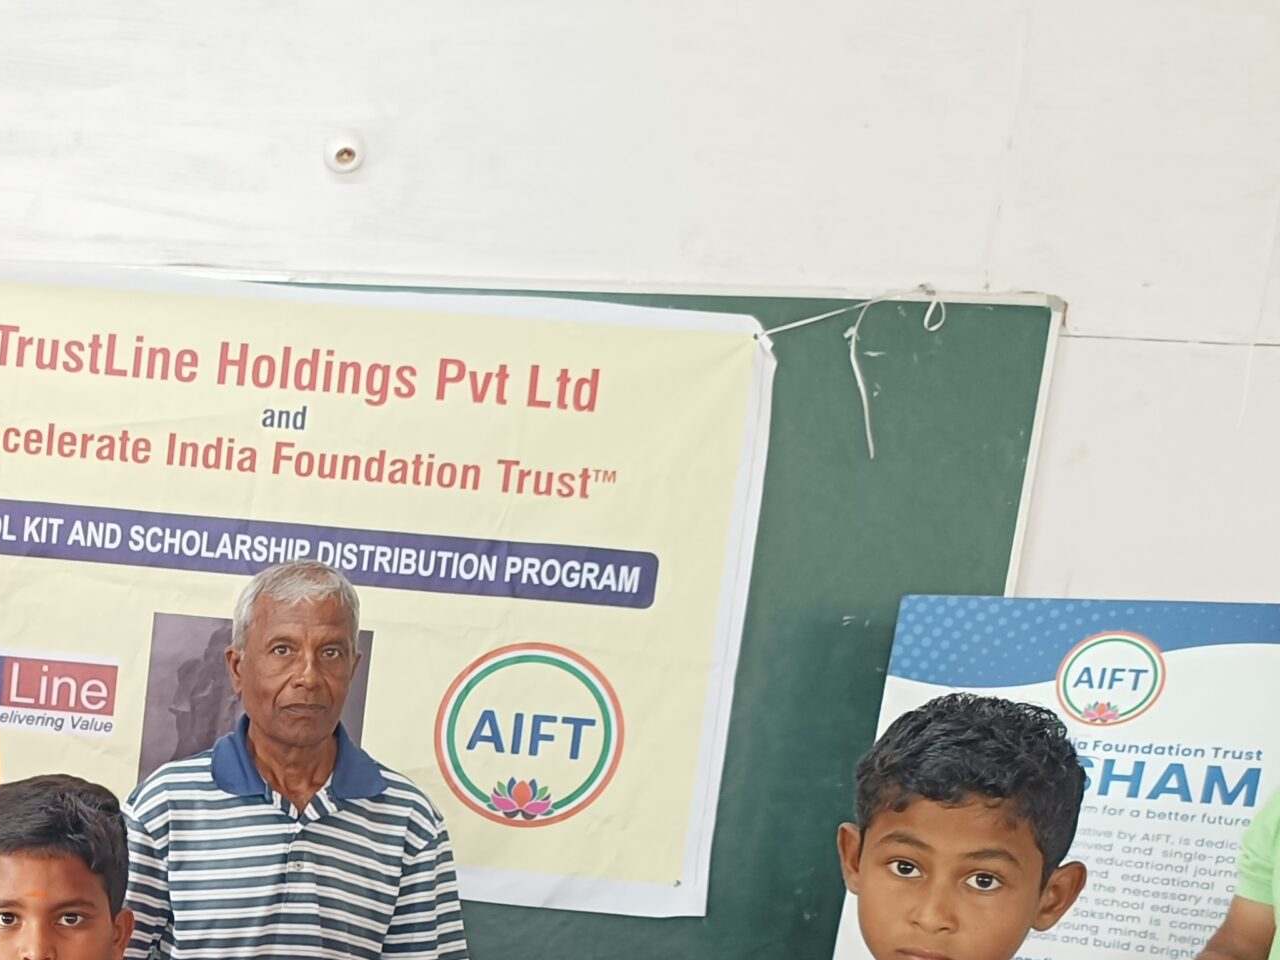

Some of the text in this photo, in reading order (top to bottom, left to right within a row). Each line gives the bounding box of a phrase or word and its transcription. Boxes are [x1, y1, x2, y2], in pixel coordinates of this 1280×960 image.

[216, 341, 418, 406] Holdings
[435, 358, 510, 406] Pvt
[526, 364, 600, 412] Ltd
[261, 405, 308, 431] and
[166, 432, 258, 473] India
[272, 441, 482, 491] Foundation
[23, 516, 64, 545] KIT
[67, 520, 122, 550] AND
[128, 524, 311, 564] SCHOLARSHIP
[317, 540, 497, 583] DISTRIBUTION
[503, 556, 642, 595] PROGRAM
[9, 662, 109, 711] Line
[1072, 665, 1150, 692] AIFT
[70, 715, 113, 733] Value
[465, 707, 597, 762] AIFT
[1092, 740, 1205, 759] Foundation
[1211, 747, 1264, 762] Trust
[1102, 804, 1125, 817] for
[1129, 809, 1141, 818] a
[1146, 808, 1197, 823] better
[1201, 813, 1252, 828] future
[1117, 828, 1137, 843] by
[1179, 836, 1191, 846] is
[1195, 837, 1243, 851] dedic
[1121, 844, 1153, 856] and
[1095, 856, 1189, 873] educational
[1121, 873, 1215, 891] educational
[1092, 883, 1117, 894] the
[1122, 888, 1203, 905] necessary
[1093, 898, 1145, 911] school
[1071, 907, 1141, 924] Saksham
[1148, 916, 1161, 927] is
[1061, 933, 1089, 946] and
[1093, 937, 1130, 952] build
[1135, 943, 1145, 953] a
[1149, 944, 1200, 960] bright
